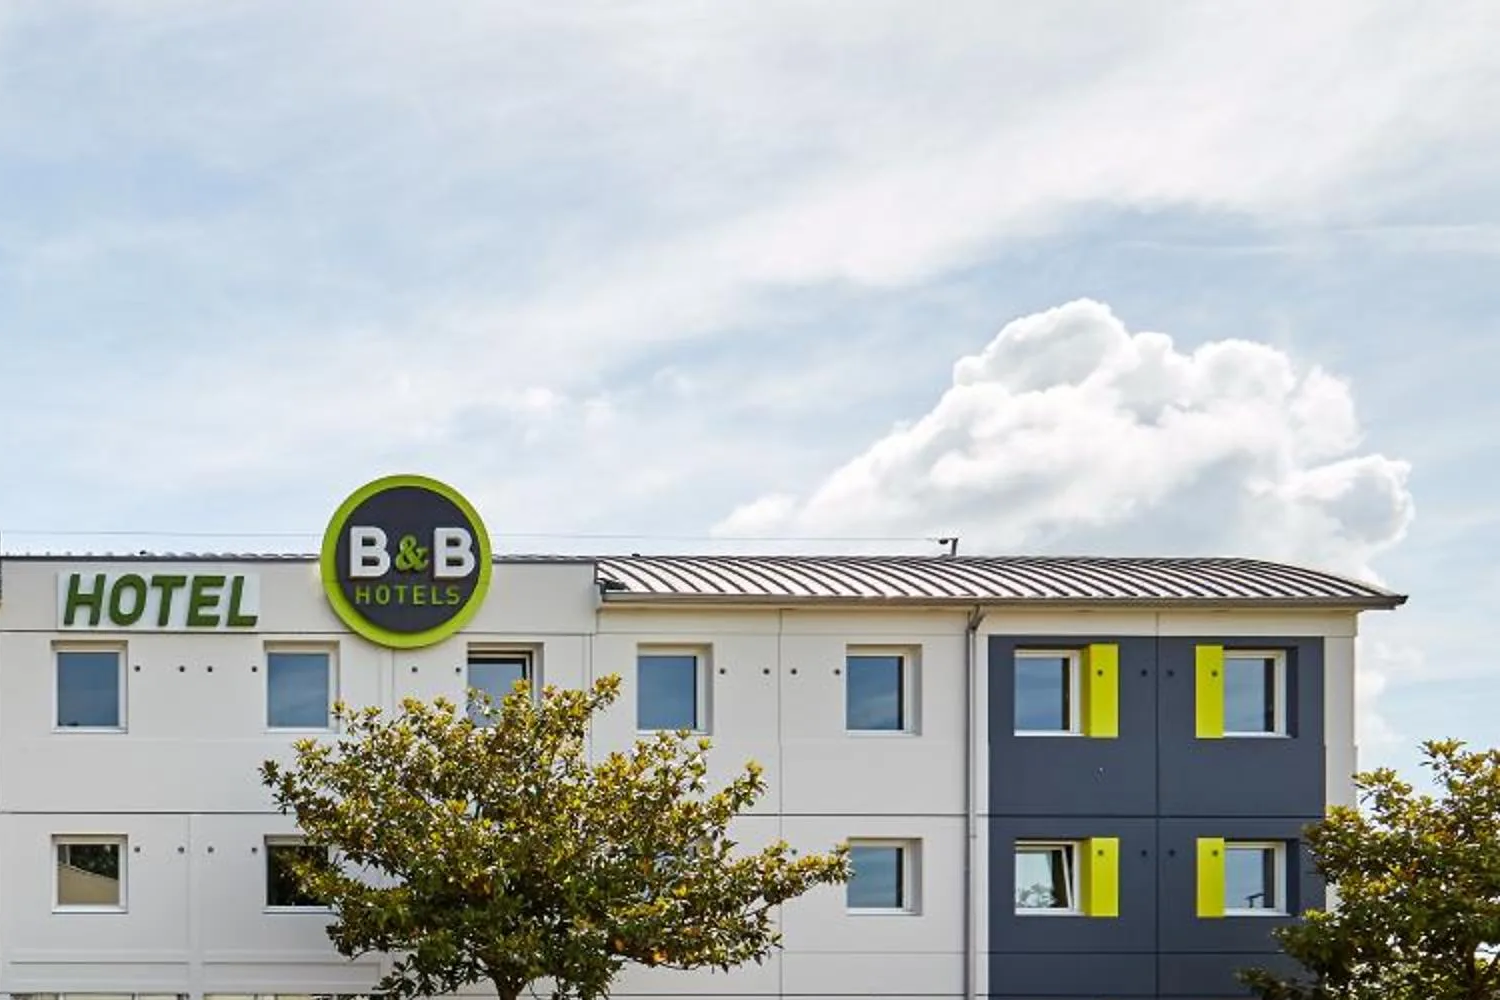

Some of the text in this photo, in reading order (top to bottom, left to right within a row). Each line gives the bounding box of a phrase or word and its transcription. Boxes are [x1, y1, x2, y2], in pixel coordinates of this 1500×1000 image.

[349, 526, 476, 579] B&B
[63, 573, 259, 627] HOTEL
[355, 585, 461, 605] HOTELS
